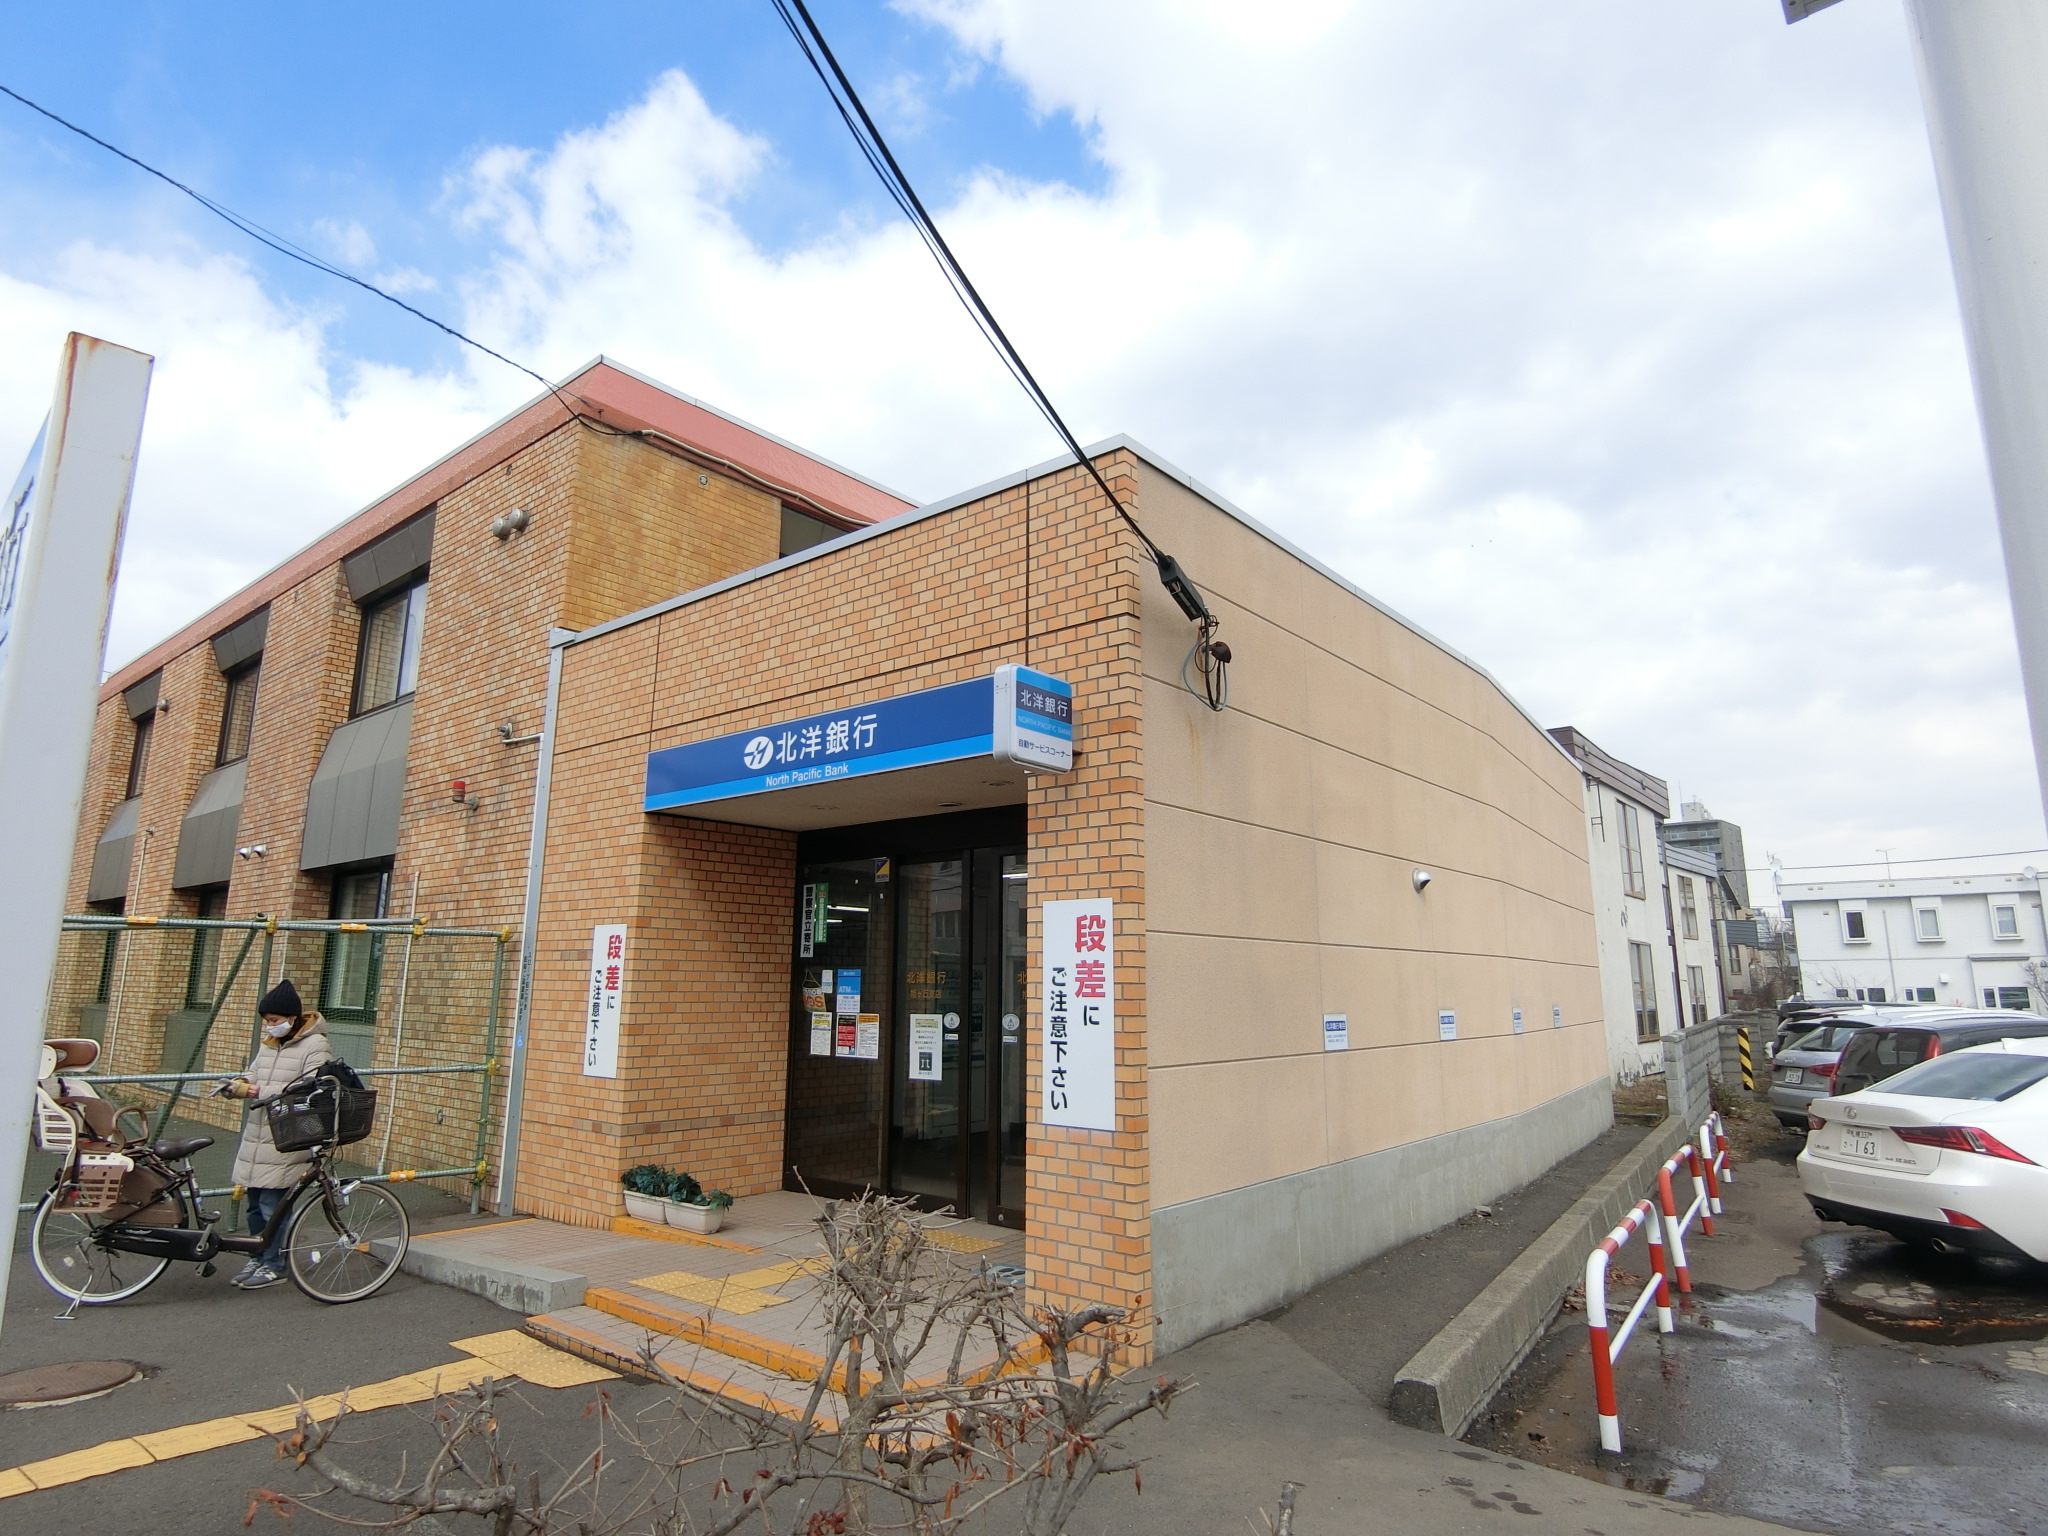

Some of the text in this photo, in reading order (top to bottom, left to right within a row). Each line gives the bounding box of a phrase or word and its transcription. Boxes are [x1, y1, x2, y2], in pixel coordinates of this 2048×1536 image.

[1021, 689, 1068, 717] 北洋銀行
[776, 714, 878, 764] 北洋銀行
[1018, 716, 1037, 727] NORTH
[1038, 721, 1057, 733] PACIFIC
[1018, 739, 1071, 758] 自動サービスコーナー
[766, 763, 849, 787] North Pacific Bank
[605, 934, 622, 1010] 段差に
[907, 971, 946, 984] 北洋銀行
[1075, 914, 1107, 1027] 段差に
[588, 969, 602, 1067] ご注意下さい
[1050, 966, 1068, 1111] ご注意下さい
